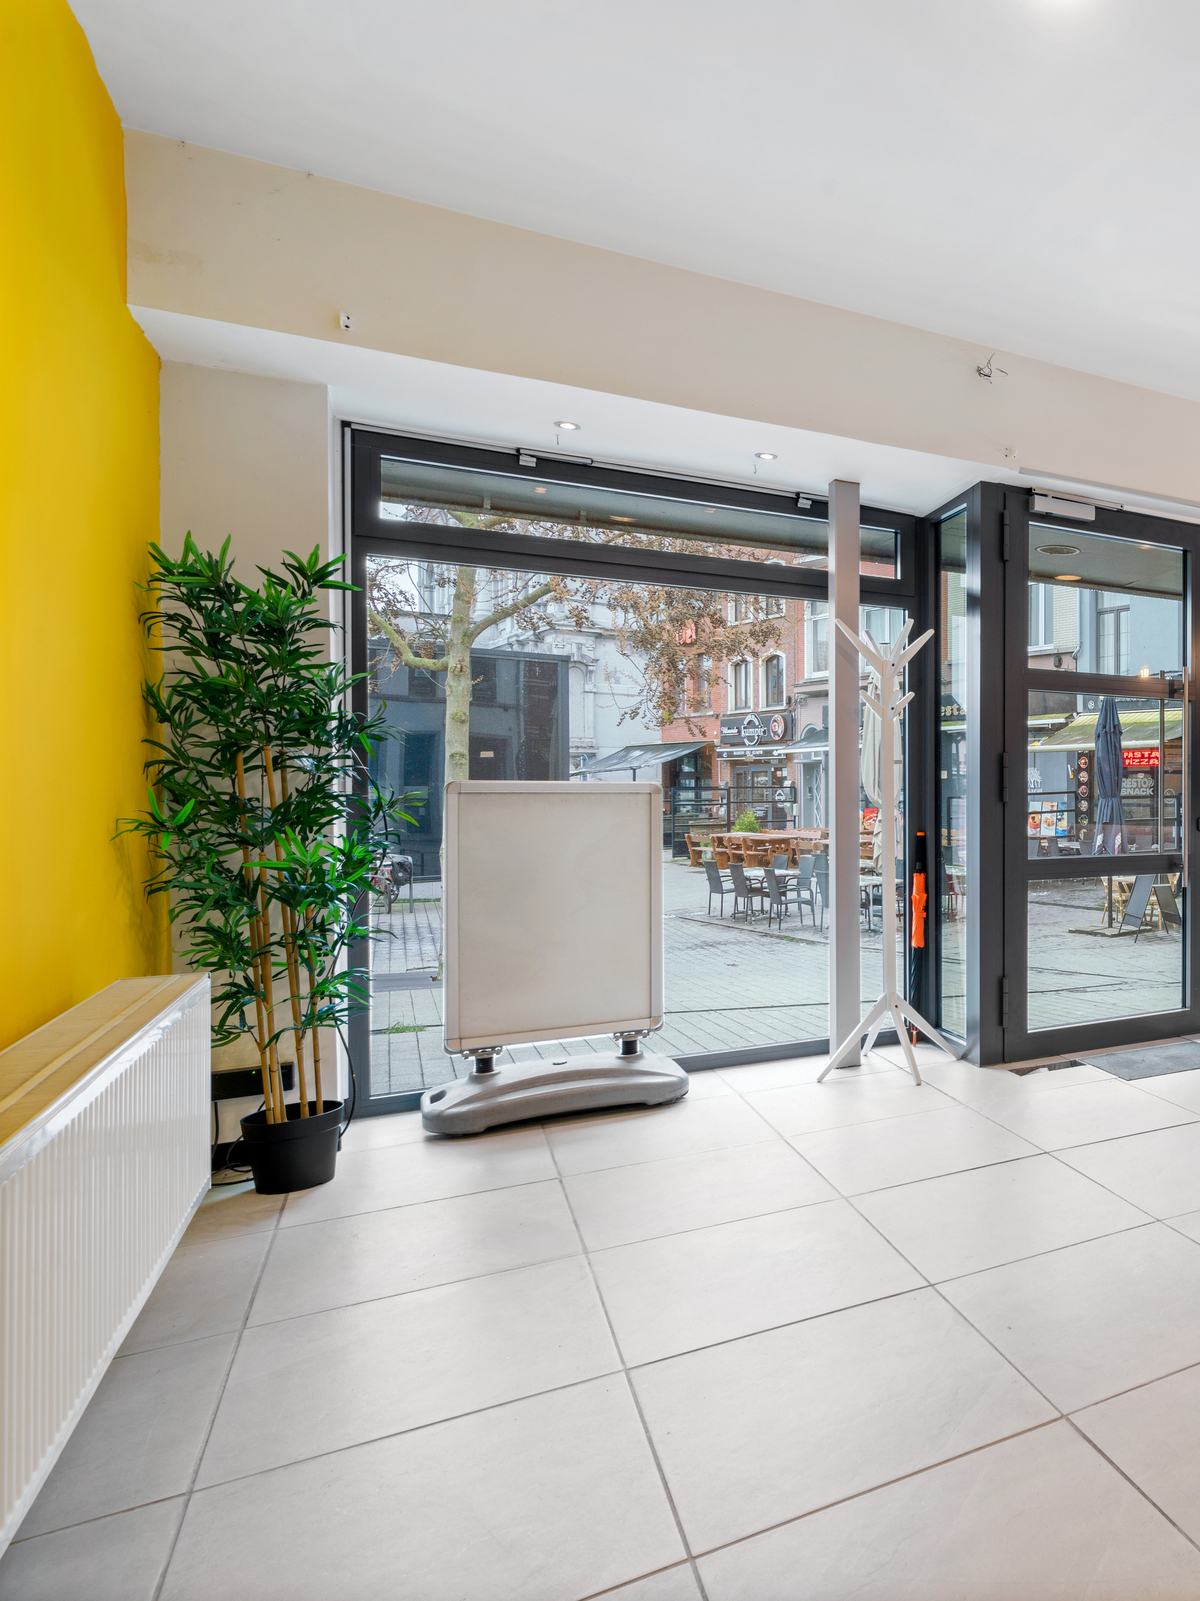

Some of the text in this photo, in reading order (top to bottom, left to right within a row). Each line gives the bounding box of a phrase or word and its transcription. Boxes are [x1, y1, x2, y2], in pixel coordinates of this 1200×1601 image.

[1123, 751, 1160, 759] PASTA
[1121, 778, 1148, 788] RESTO
[1120, 788, 1153, 796] SNACK
